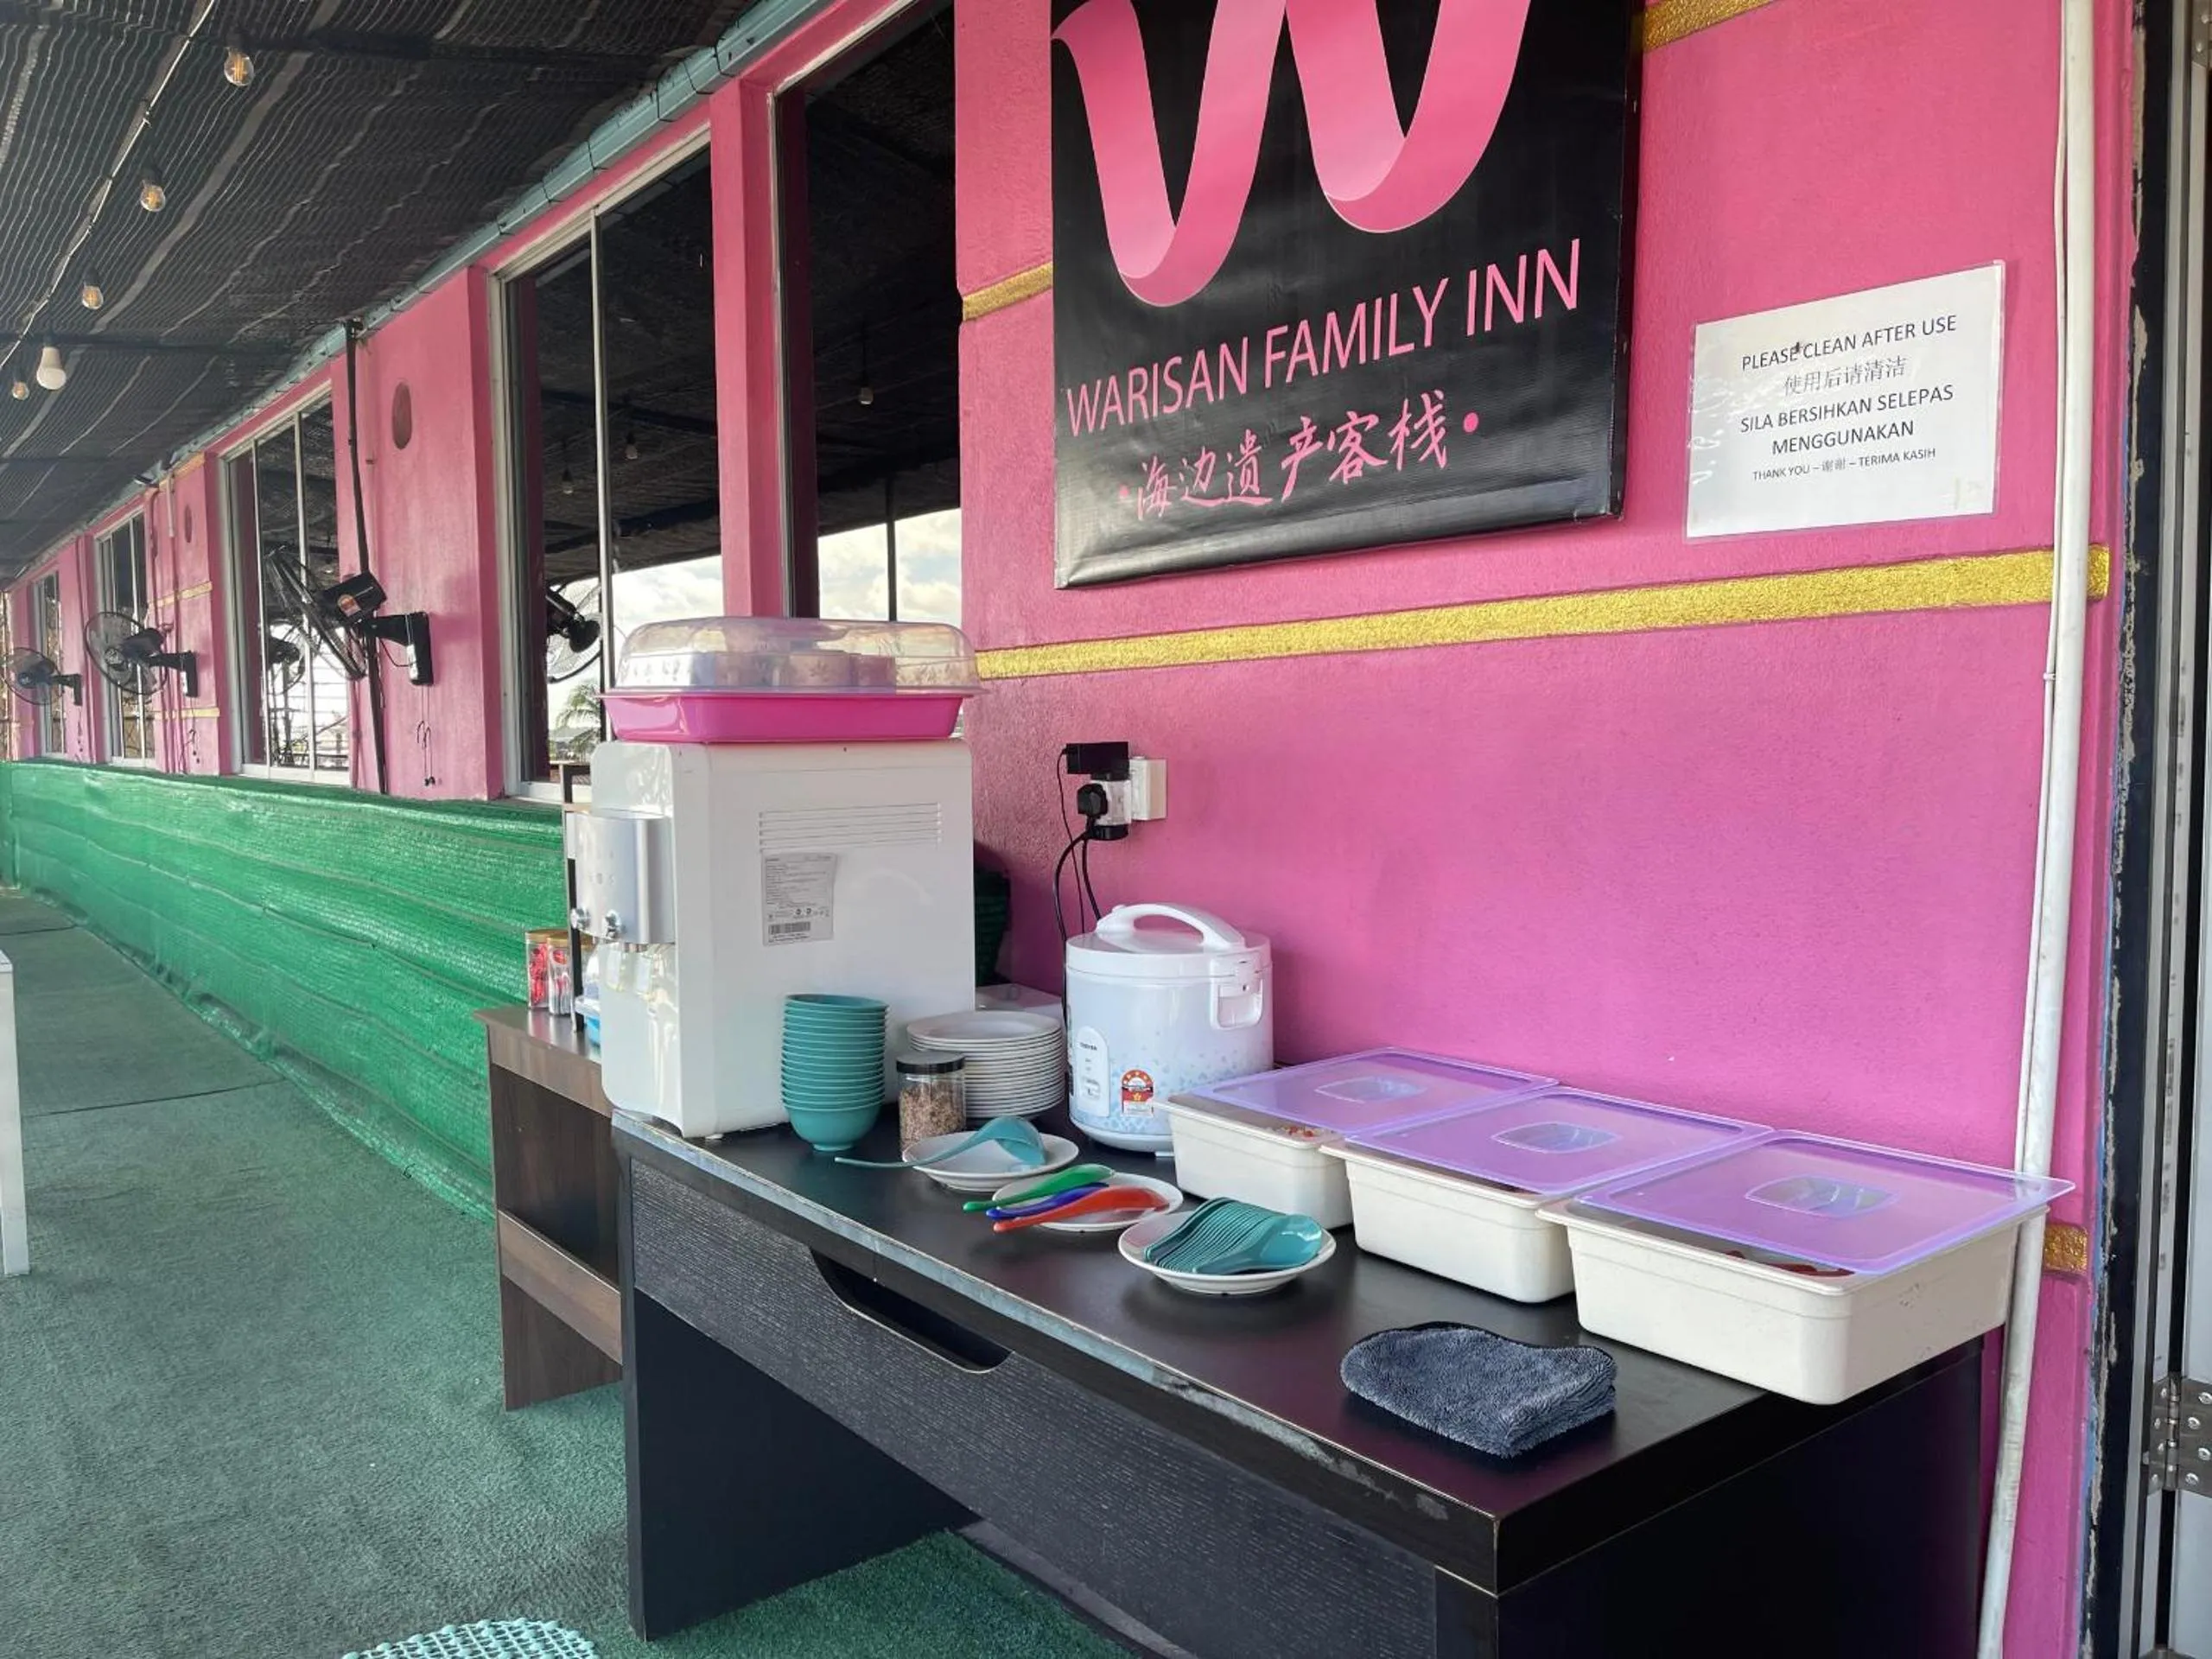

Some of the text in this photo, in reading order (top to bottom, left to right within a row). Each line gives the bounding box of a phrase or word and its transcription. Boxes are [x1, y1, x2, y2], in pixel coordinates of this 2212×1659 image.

[1067, 238, 1580, 437] WARISAN FAMILY INN
[1741, 315, 1957, 372] PLEASE CLEAN AFTER USE
[1783, 355, 1907, 396] 使用后请清洁
[1740, 384, 1955, 434] SILA BERSIHKAN SELEPAS
[1137, 390, 1449, 522] 海边遗产客栈
[1771, 420, 1915, 455] MENGGUNAKAN
[1752, 467, 1787, 481] THANK
[1788, 464, 1811, 477] YOU
[1858, 452, 1900, 467] TERIMA
[1903, 448, 1936, 461] KASIH
